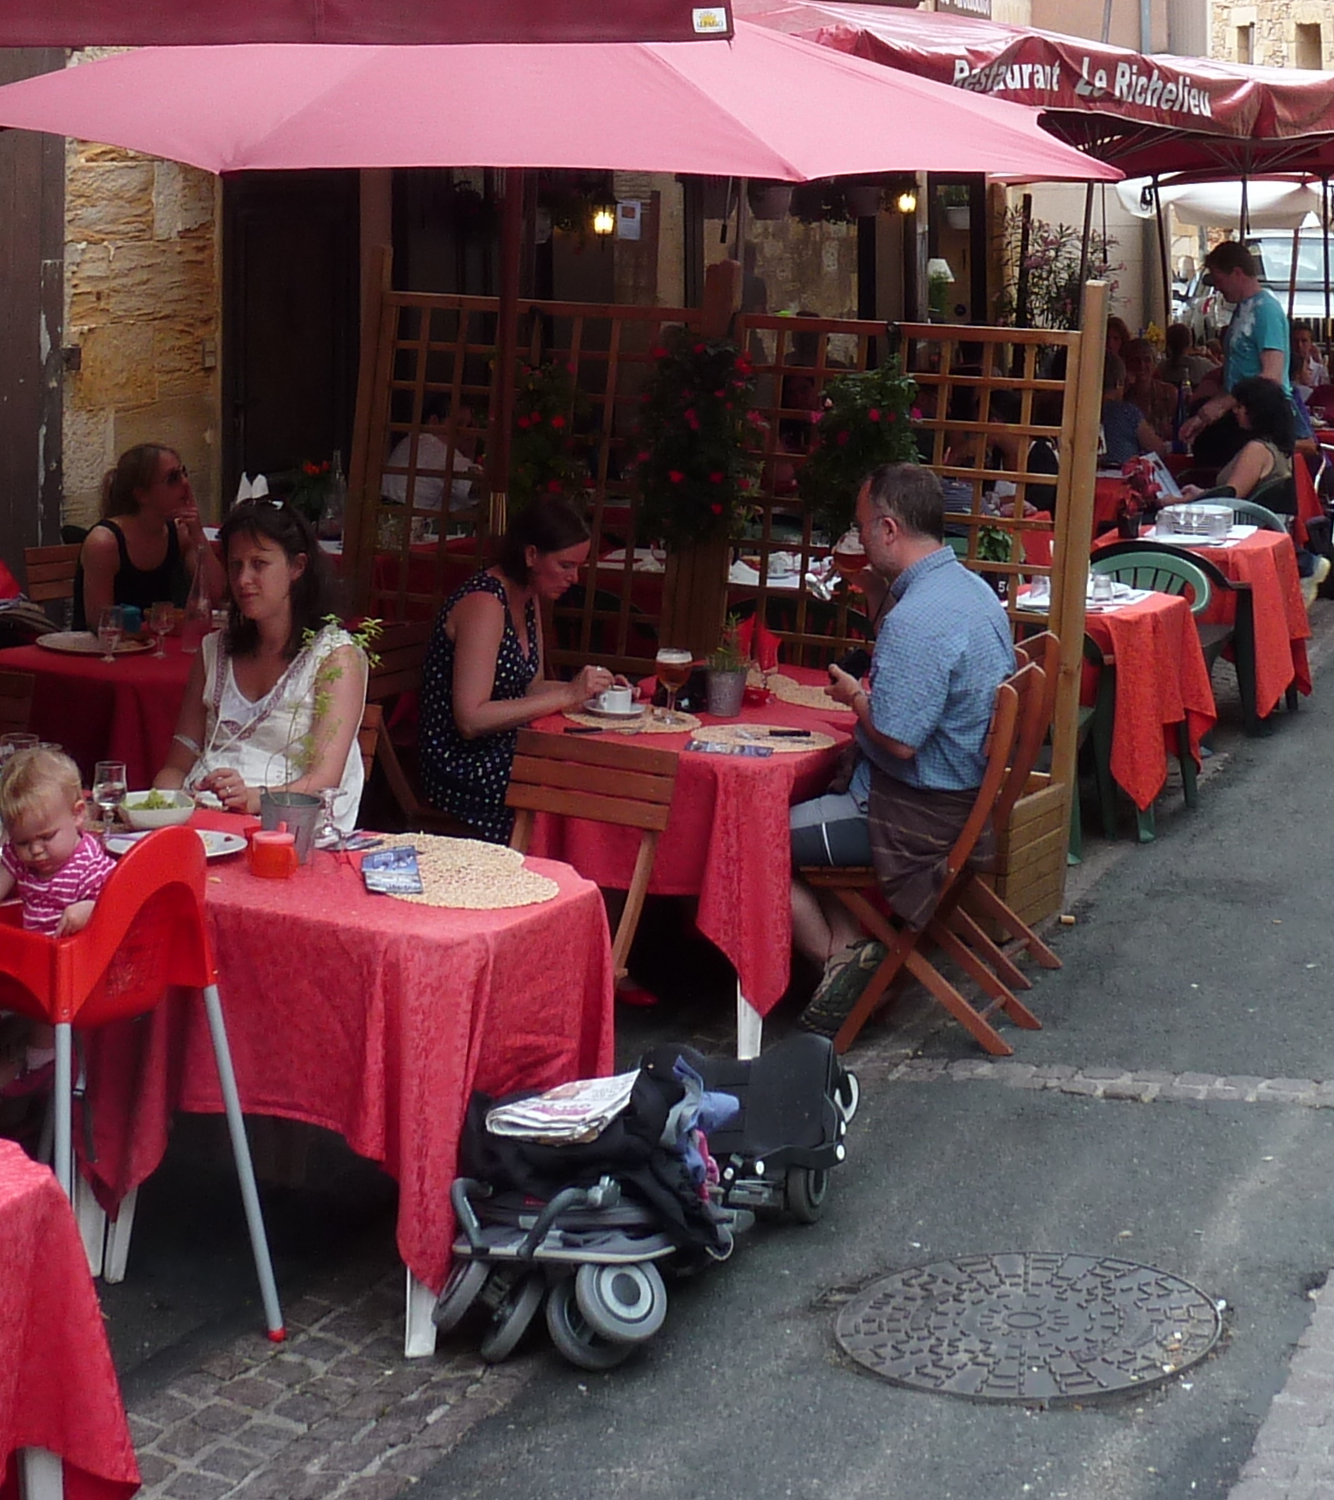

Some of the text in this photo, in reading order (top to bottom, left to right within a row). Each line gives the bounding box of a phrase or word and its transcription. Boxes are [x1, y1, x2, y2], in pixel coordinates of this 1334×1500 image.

[952, 56, 1212, 118] Restaurant Le Richelieu
